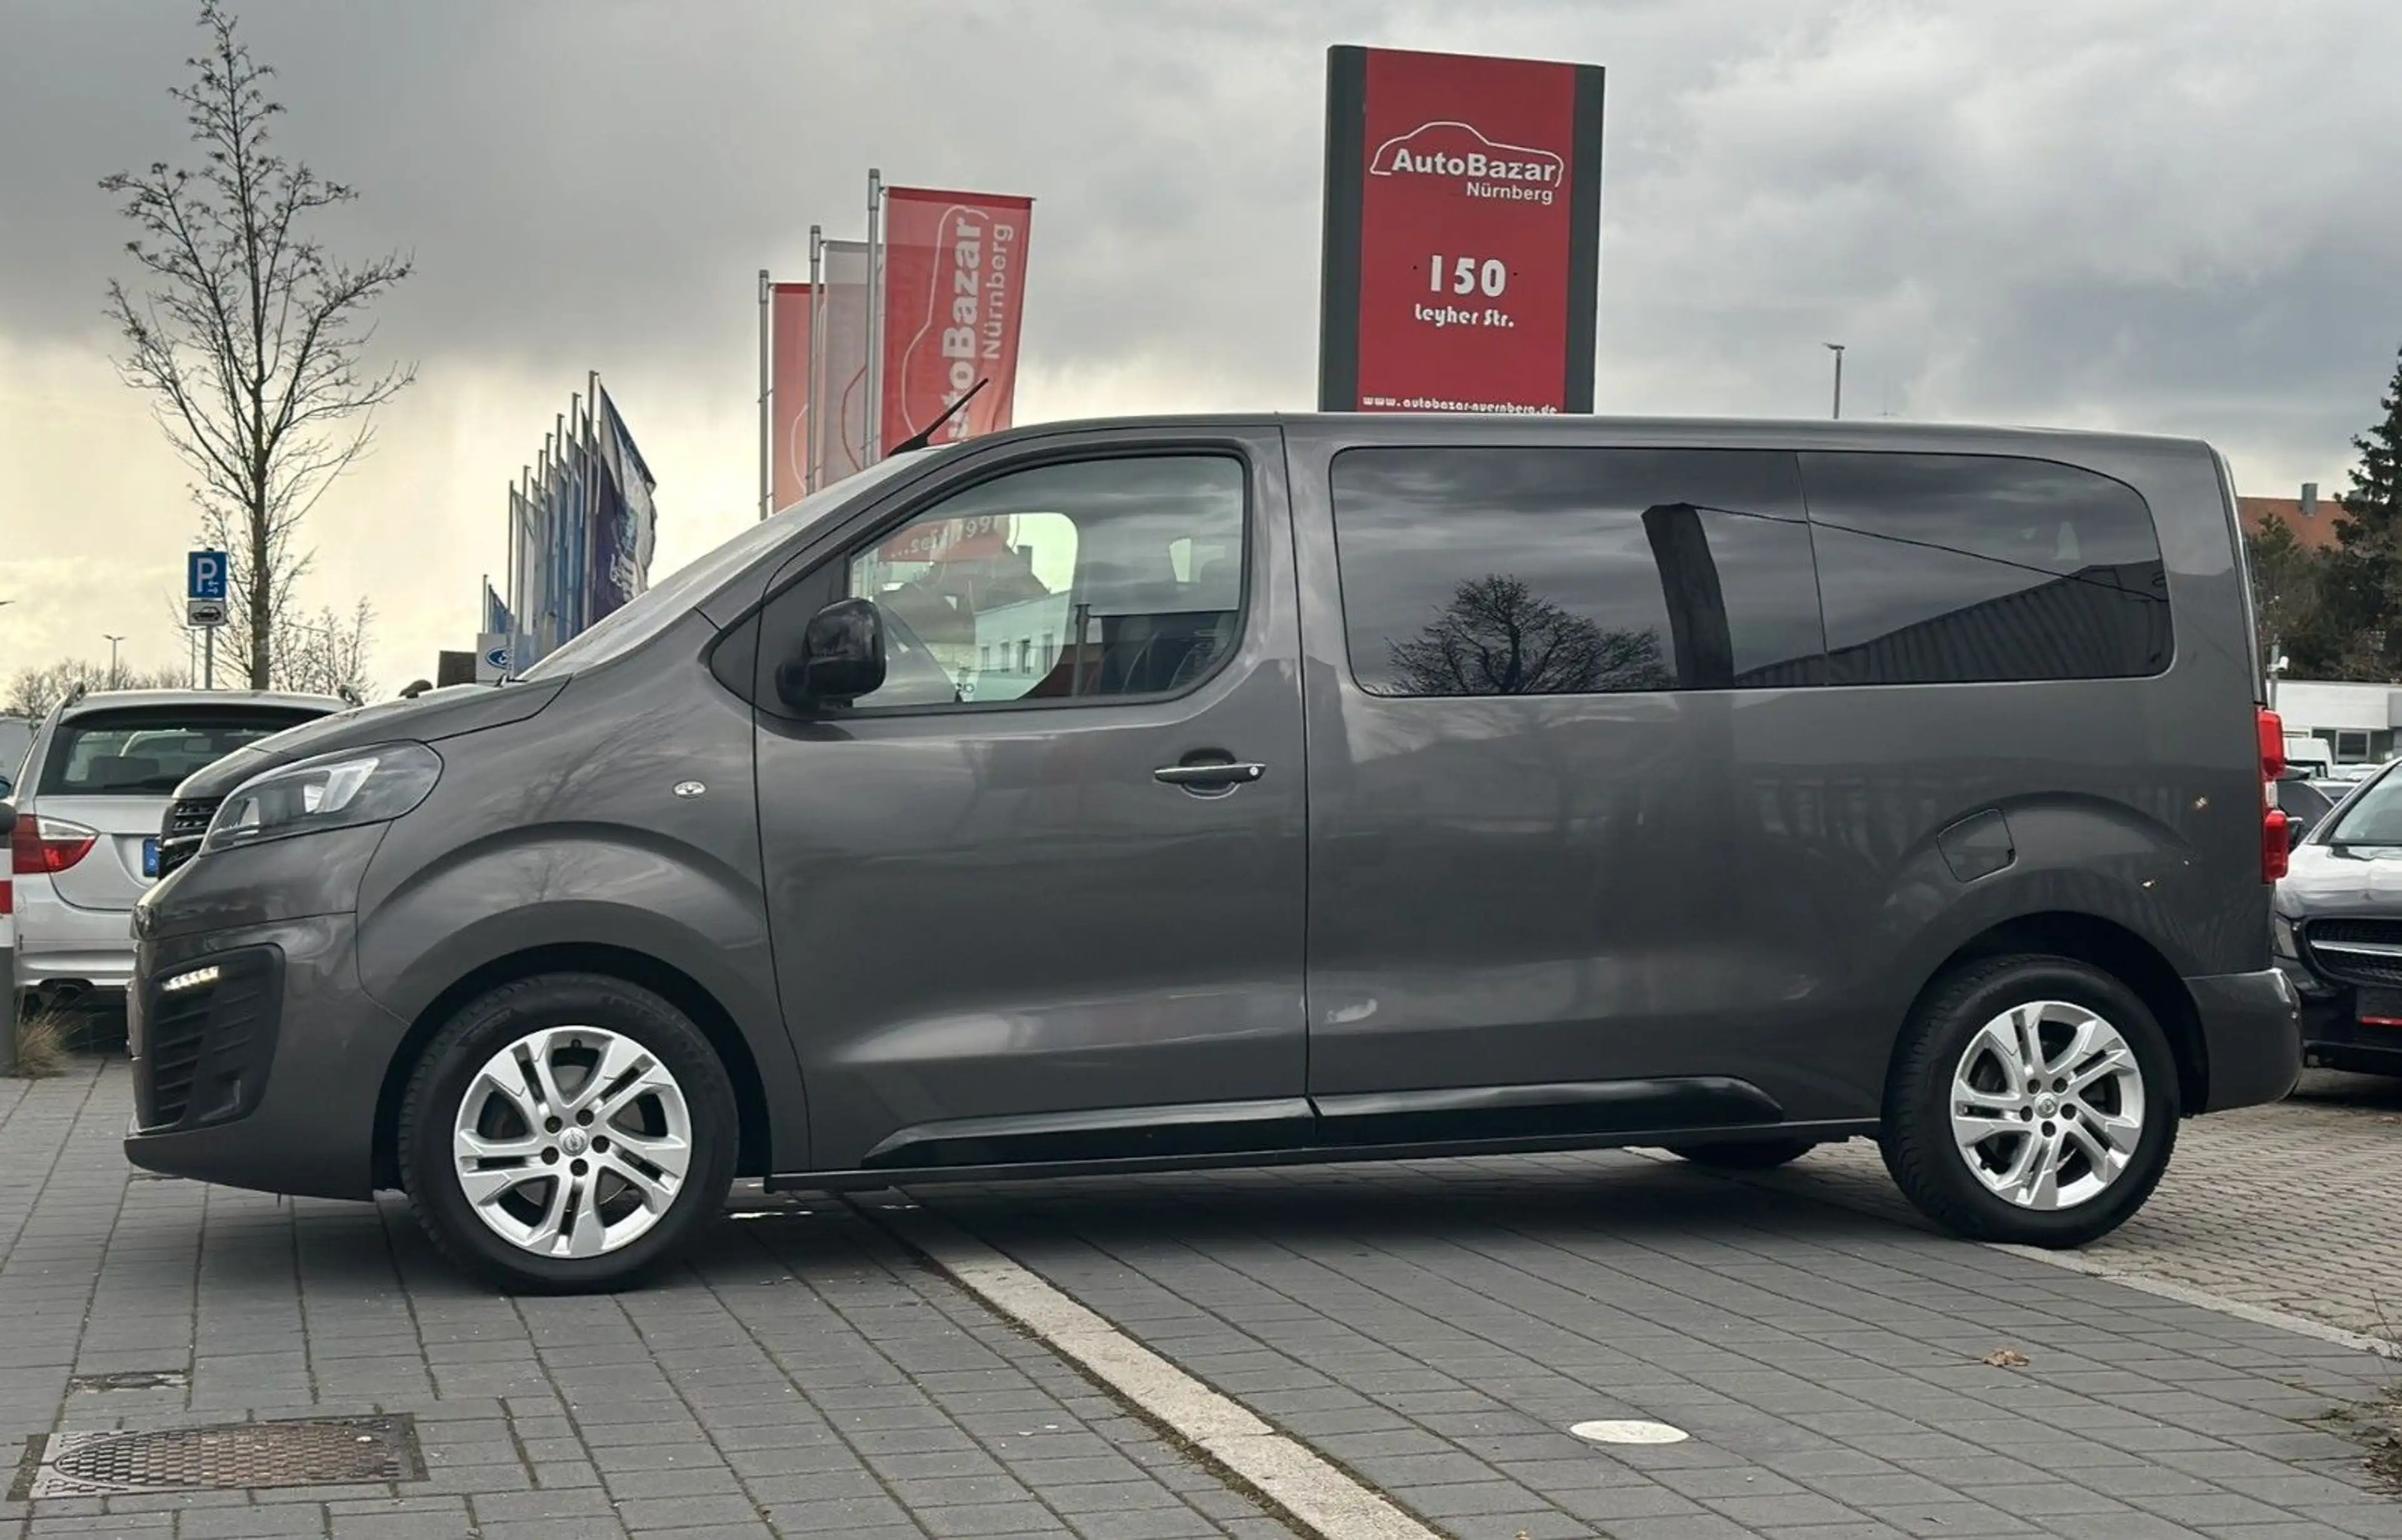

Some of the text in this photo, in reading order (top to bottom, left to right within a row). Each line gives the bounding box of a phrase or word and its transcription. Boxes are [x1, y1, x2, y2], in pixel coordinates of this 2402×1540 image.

[1392, 148, 1557, 181] AutoBazar
[1467, 181, 1553, 205] Nürnberg
[982, 224, 1013, 359] Nürnberg
[1431, 255, 1506, 297] 150
[1483, 309, 1514, 328] Str.
[197, 558, 218, 592] P
